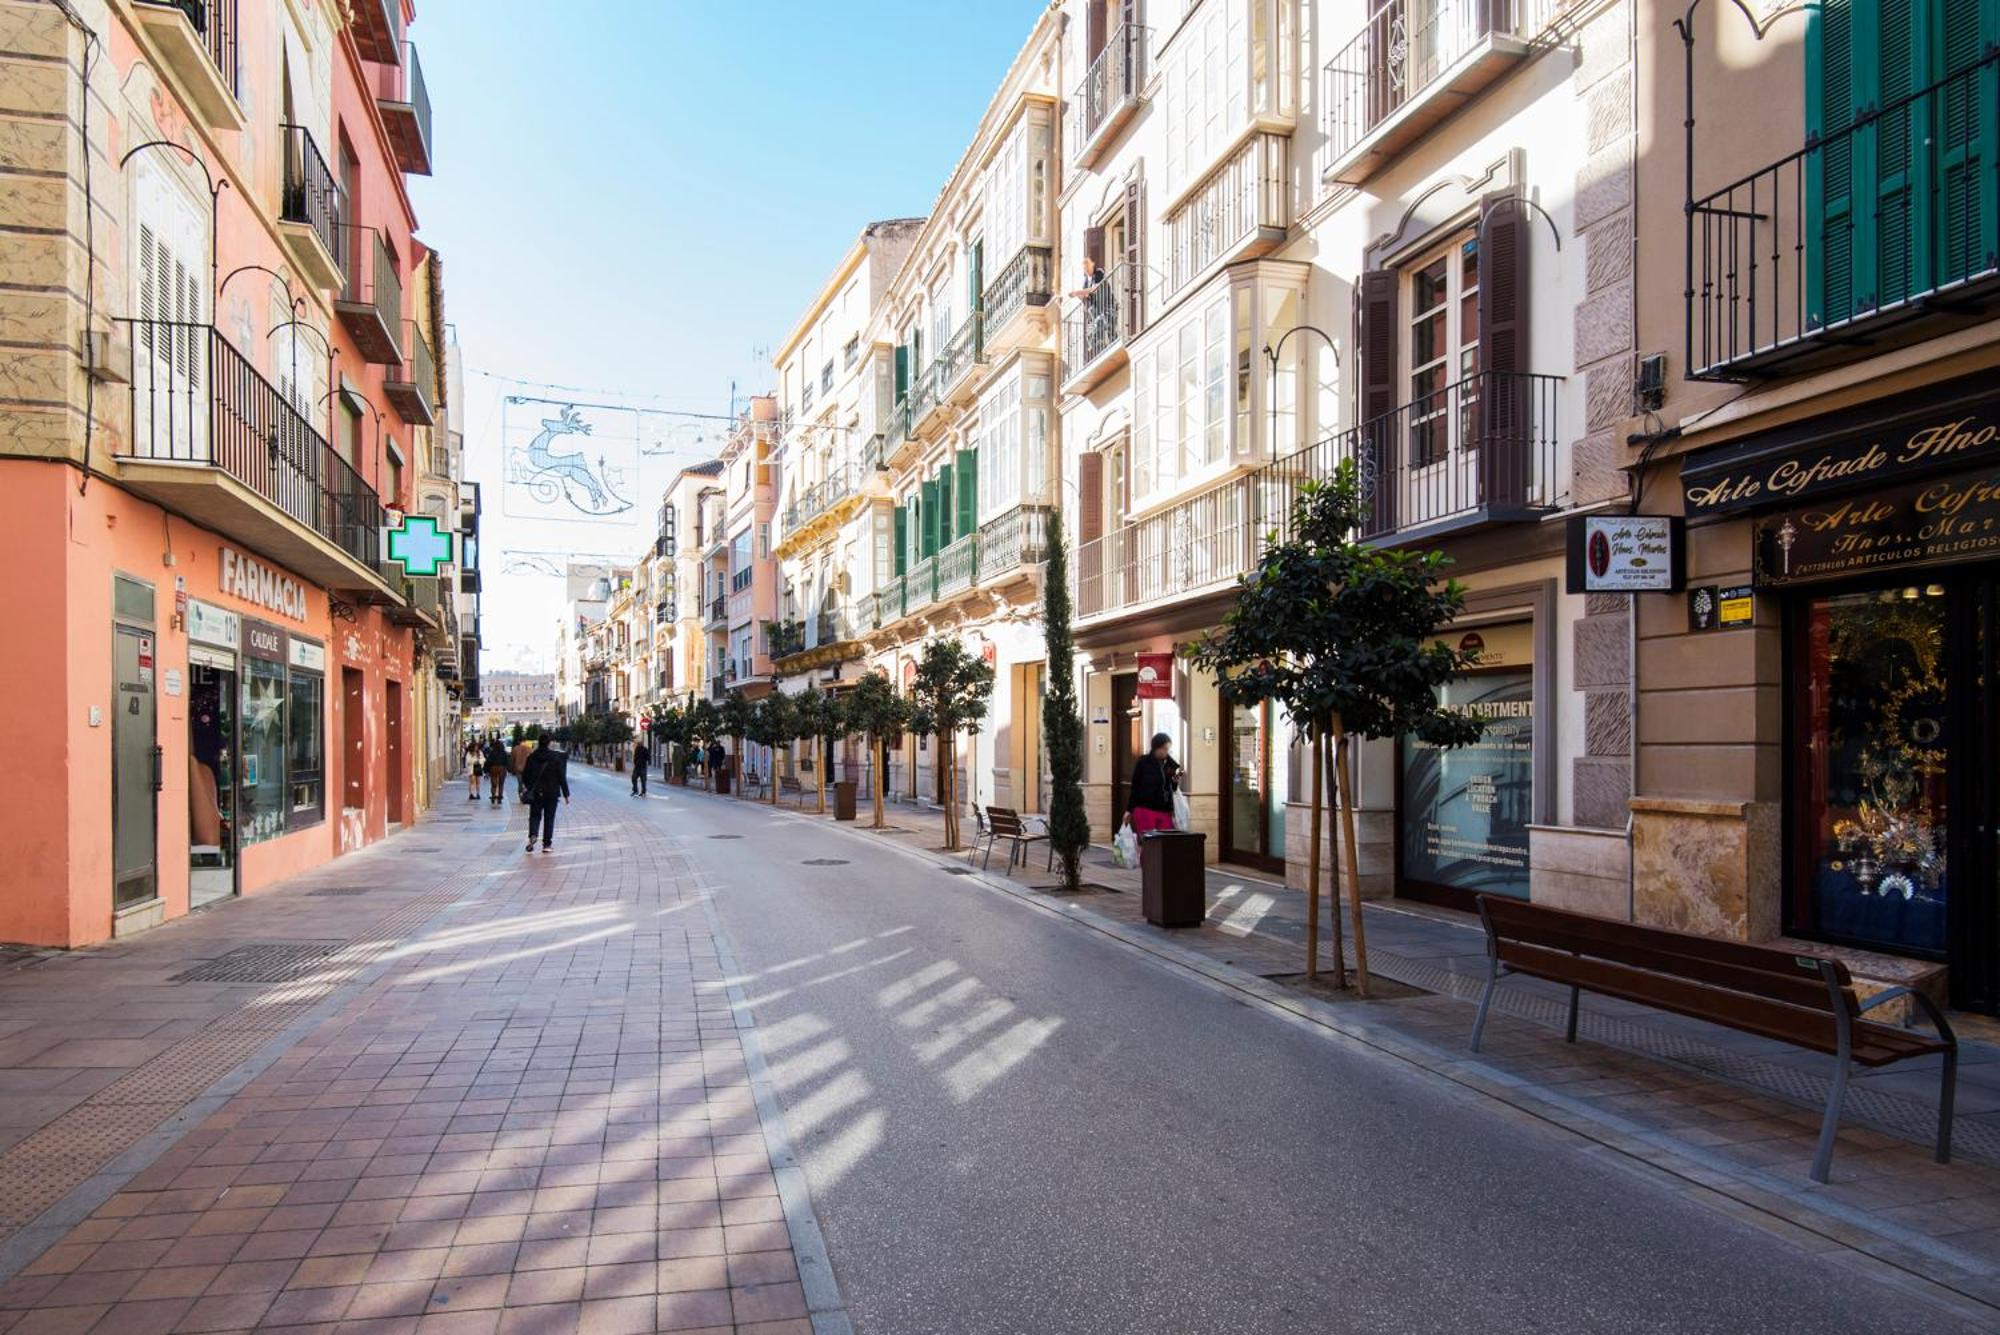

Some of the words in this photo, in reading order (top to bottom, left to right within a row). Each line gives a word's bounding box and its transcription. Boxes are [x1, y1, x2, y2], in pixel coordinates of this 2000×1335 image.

[1687, 476, 1760, 507] Arte
[1767, 444, 1887, 496] Cofrade
[1802, 501, 1896, 531] Arte
[1927, 535, 2000, 555] RELIGIOS
[222, 547, 306, 622] FARMACIA
